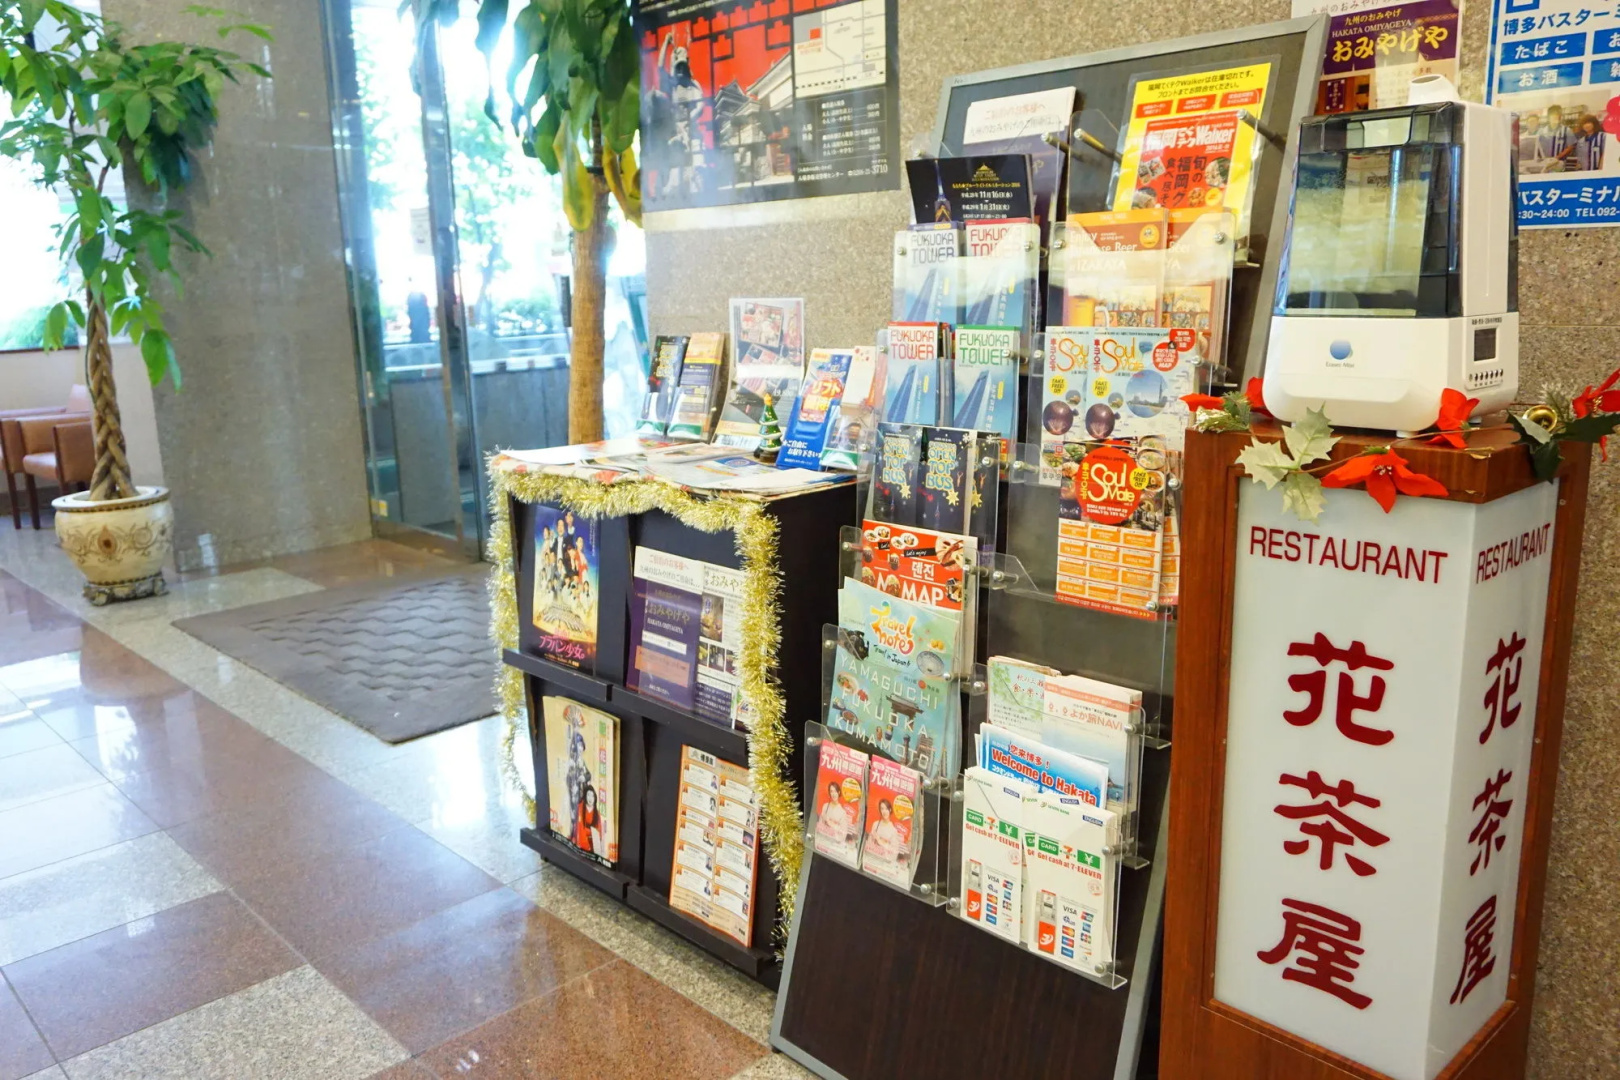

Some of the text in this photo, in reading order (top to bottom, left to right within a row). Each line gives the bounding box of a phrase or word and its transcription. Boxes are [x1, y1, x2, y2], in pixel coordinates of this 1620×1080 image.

[1345, 8, 1402, 26] 九州のおみやげ
[1332, 19, 1412, 38] HAKATA OMIYAGEYA
[1332, 26, 1448, 62] おみやげや
[1515, 40, 1568, 59] たばこ
[1519, 69, 1558, 87] お酒
[1196, 124, 1236, 145] Walker
[1575, 208, 1595, 217] TEL
[911, 232, 954, 246] FUKUOKA
[911, 247, 955, 265] TOWER
[890, 330, 934, 342] FUKUOKA
[960, 333, 1010, 347] FUKUOKA
[891, 344, 934, 360] TOWER
[1101, 336, 1135, 374] Soul
[885, 455, 907, 468] TOP
[928, 447, 956, 461] OPEN
[883, 468, 906, 484] BUS
[928, 460, 955, 474] TOP
[927, 474, 953, 490] BUS
[1087, 463, 1127, 502] Soul
[1106, 487, 1135, 503] Mate
[1250, 525, 1448, 584] RESTAURANT
[1476, 522, 1551, 584] RESTAURANT
[911, 561, 935, 581] 덴진
[901, 580, 944, 607] MAP
[879, 630, 914, 655] note
[839, 654, 938, 710] YAMAGUCHI
[841, 687, 928, 738] FUKUOKA
[834, 713, 929, 770] KUMAMOTO
[992, 748, 1097, 807] Welcome to Hakata
[968, 812, 982, 823] CARD
[1257, 631, 1395, 1010] 花茶屋
[1449, 630, 1527, 1005] 花茶屋
[975, 826, 987, 836] cash
[1040, 842, 1057, 852] CARD
[1037, 852, 1048, 861] Get
[1048, 855, 1062, 867] cash
[987, 874, 1000, 884] VISA
[1063, 905, 1077, 915] VISA
